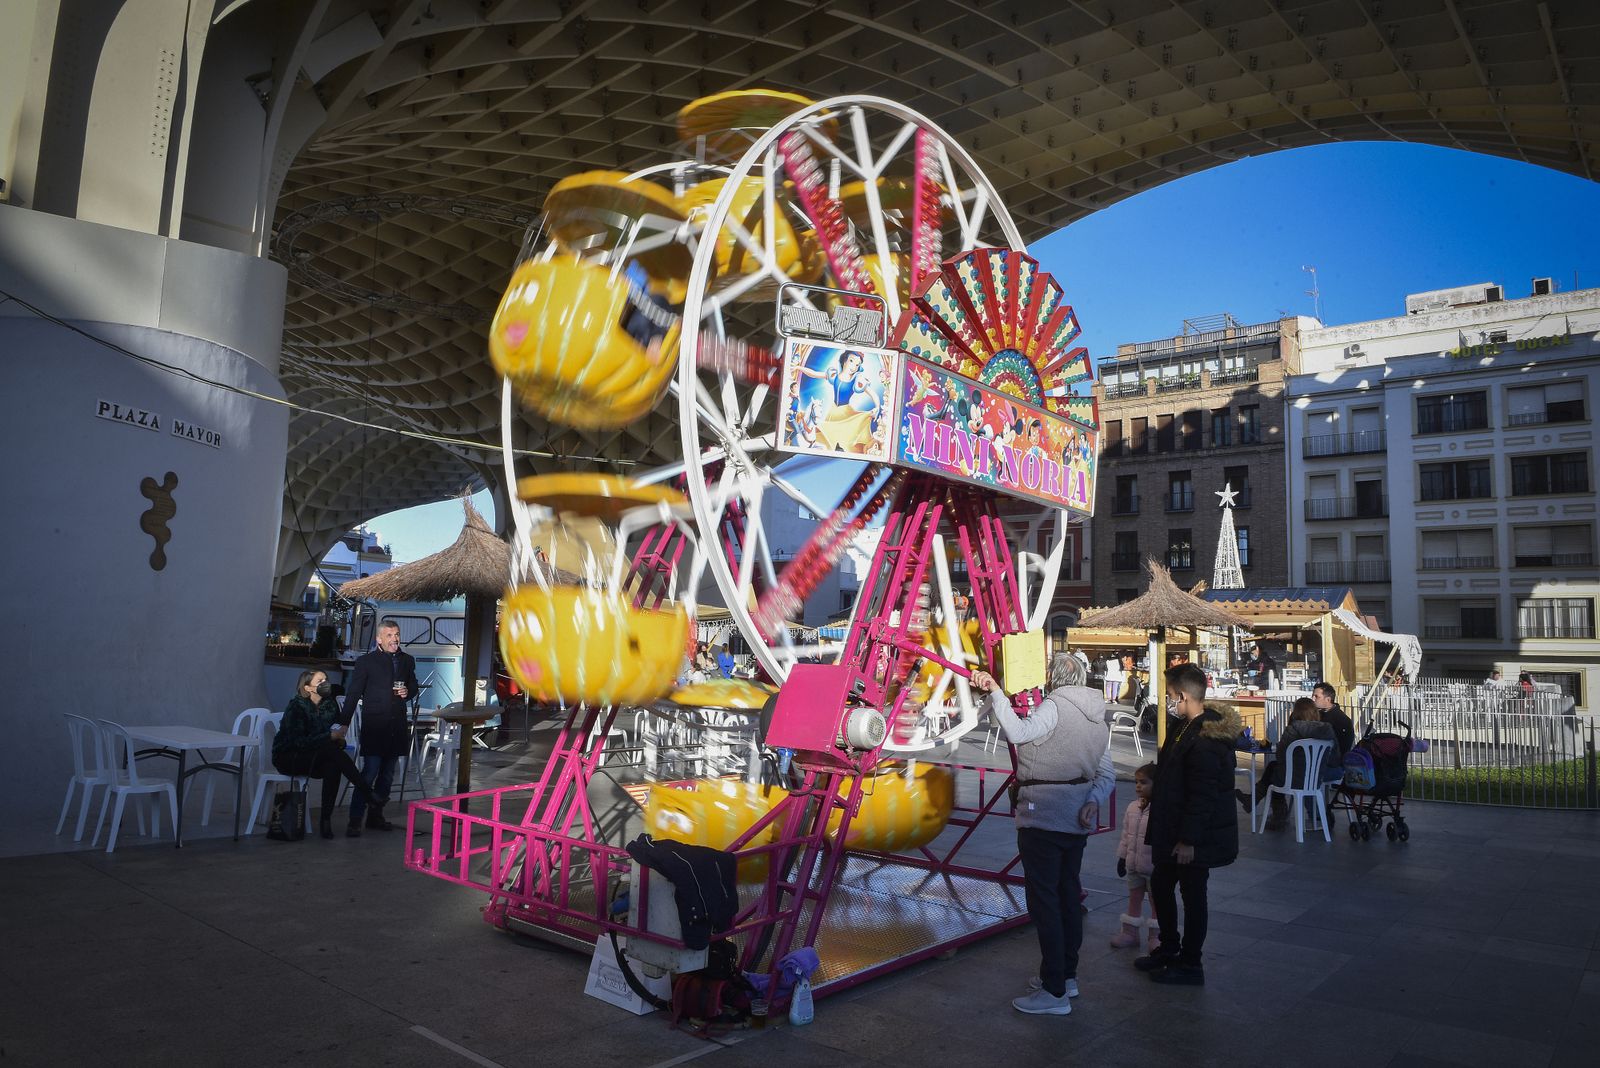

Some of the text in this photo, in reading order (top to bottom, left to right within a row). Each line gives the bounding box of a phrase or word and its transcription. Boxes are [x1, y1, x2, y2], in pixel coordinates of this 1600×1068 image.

[1450, 333, 1572, 359] HOTEL DUCAL
[98, 401, 220, 447] PLAZA MAYOR
[905, 413, 1087, 504] MINI NORIA
